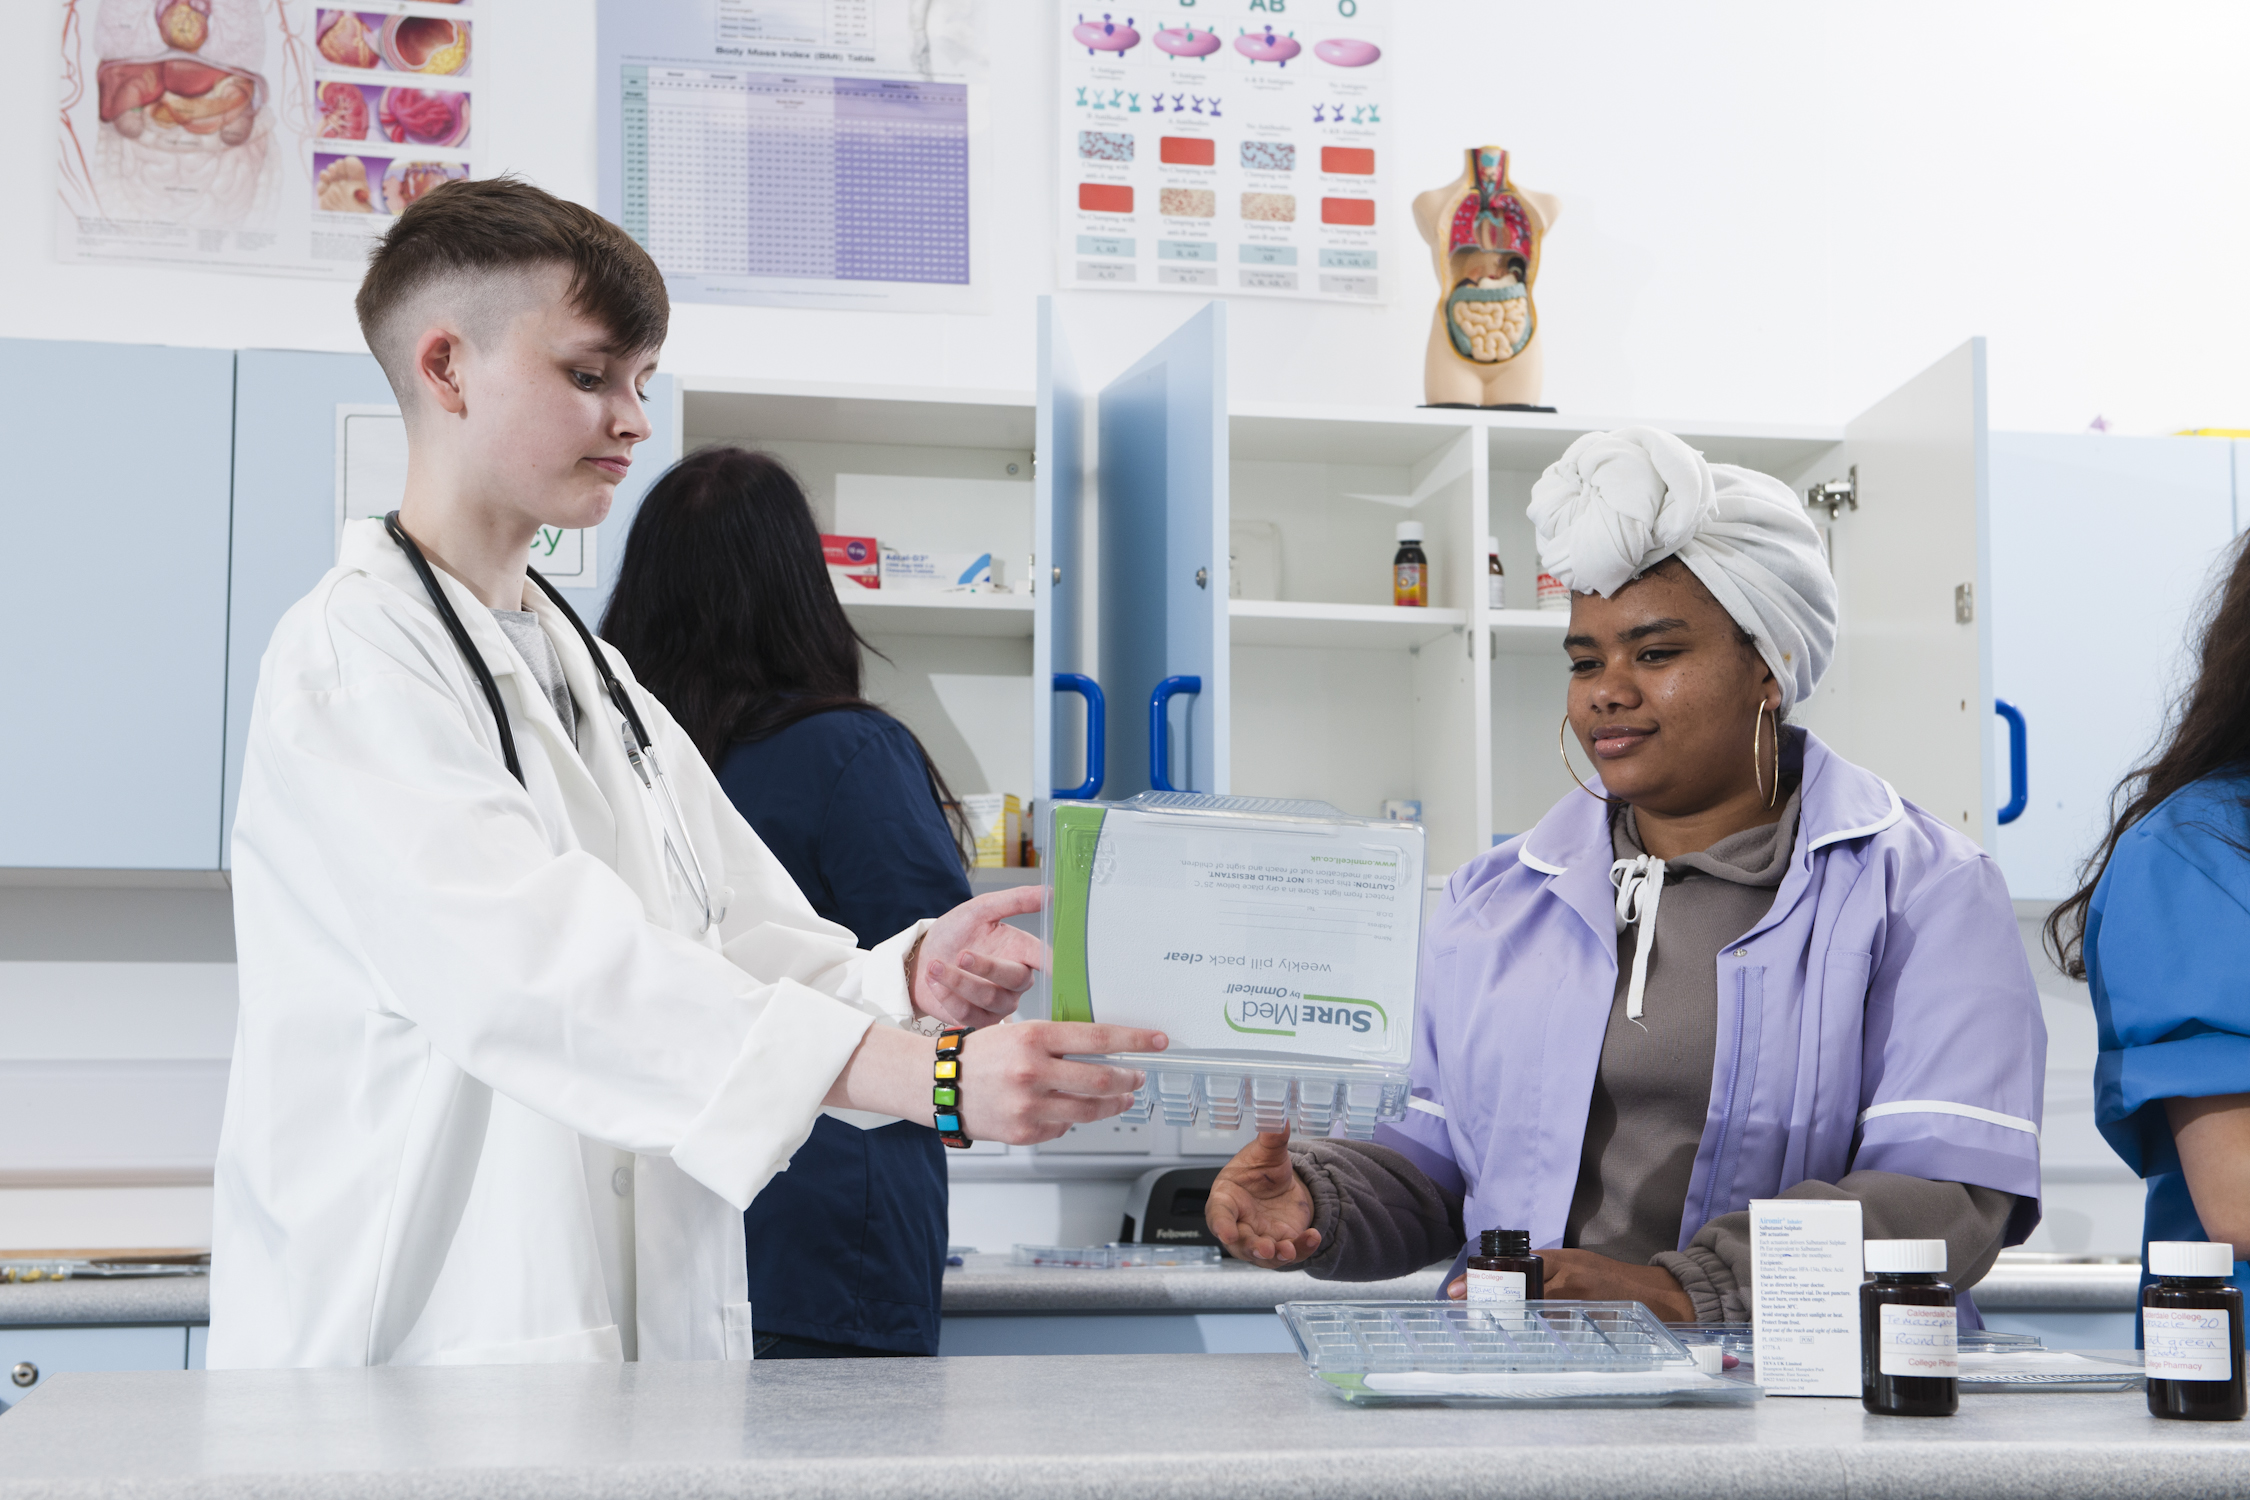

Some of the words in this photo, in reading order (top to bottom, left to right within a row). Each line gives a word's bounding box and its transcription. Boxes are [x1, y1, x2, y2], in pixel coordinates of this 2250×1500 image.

[1249, 0, 1286, 12] AB
[1338, 0, 1356, 17] O
[716, 46, 744, 56] Body
[747, 48, 777, 57] Mass
[781, 51, 810, 59] Index
[1180, 860, 1213, 868] children.
[1311, 855, 1396, 867] www.omnicell.co.uk
[1226, 863, 1245, 871] sight
[1208, 871, 1255, 880] RESISTANT.
[1258, 874, 1283, 882] CHILD
[1316, 870, 1360, 878] medication
[1374, 874, 1396, 882] Store
[1286, 876, 1304, 884] NOT
[1337, 879, 1351, 887] this
[1266, 884, 1279, 892] dry
[1353, 881, 1395, 891] CAUTION:
[1298, 887, 1319, 895] Store
[1322, 889, 1341, 897] light.
[1366, 893, 1394, 901] Protect
[1164, 952, 1203, 964] clear
[1209, 954, 1245, 966] pack
[1251, 958, 1273, 970] pill
[1278, 958, 1332, 972] weekly
[1290, 991, 1300, 999] by
[1481, 1273, 1503, 1281] College
[1907, 1309, 1945, 1317] Calderdale
[2171, 1312, 2201, 1322] College
[2199, 1318, 2219, 1329] 20
[1908, 1358, 1937, 1368] College
[2163, 1361, 2202, 1370] Pharmacy
